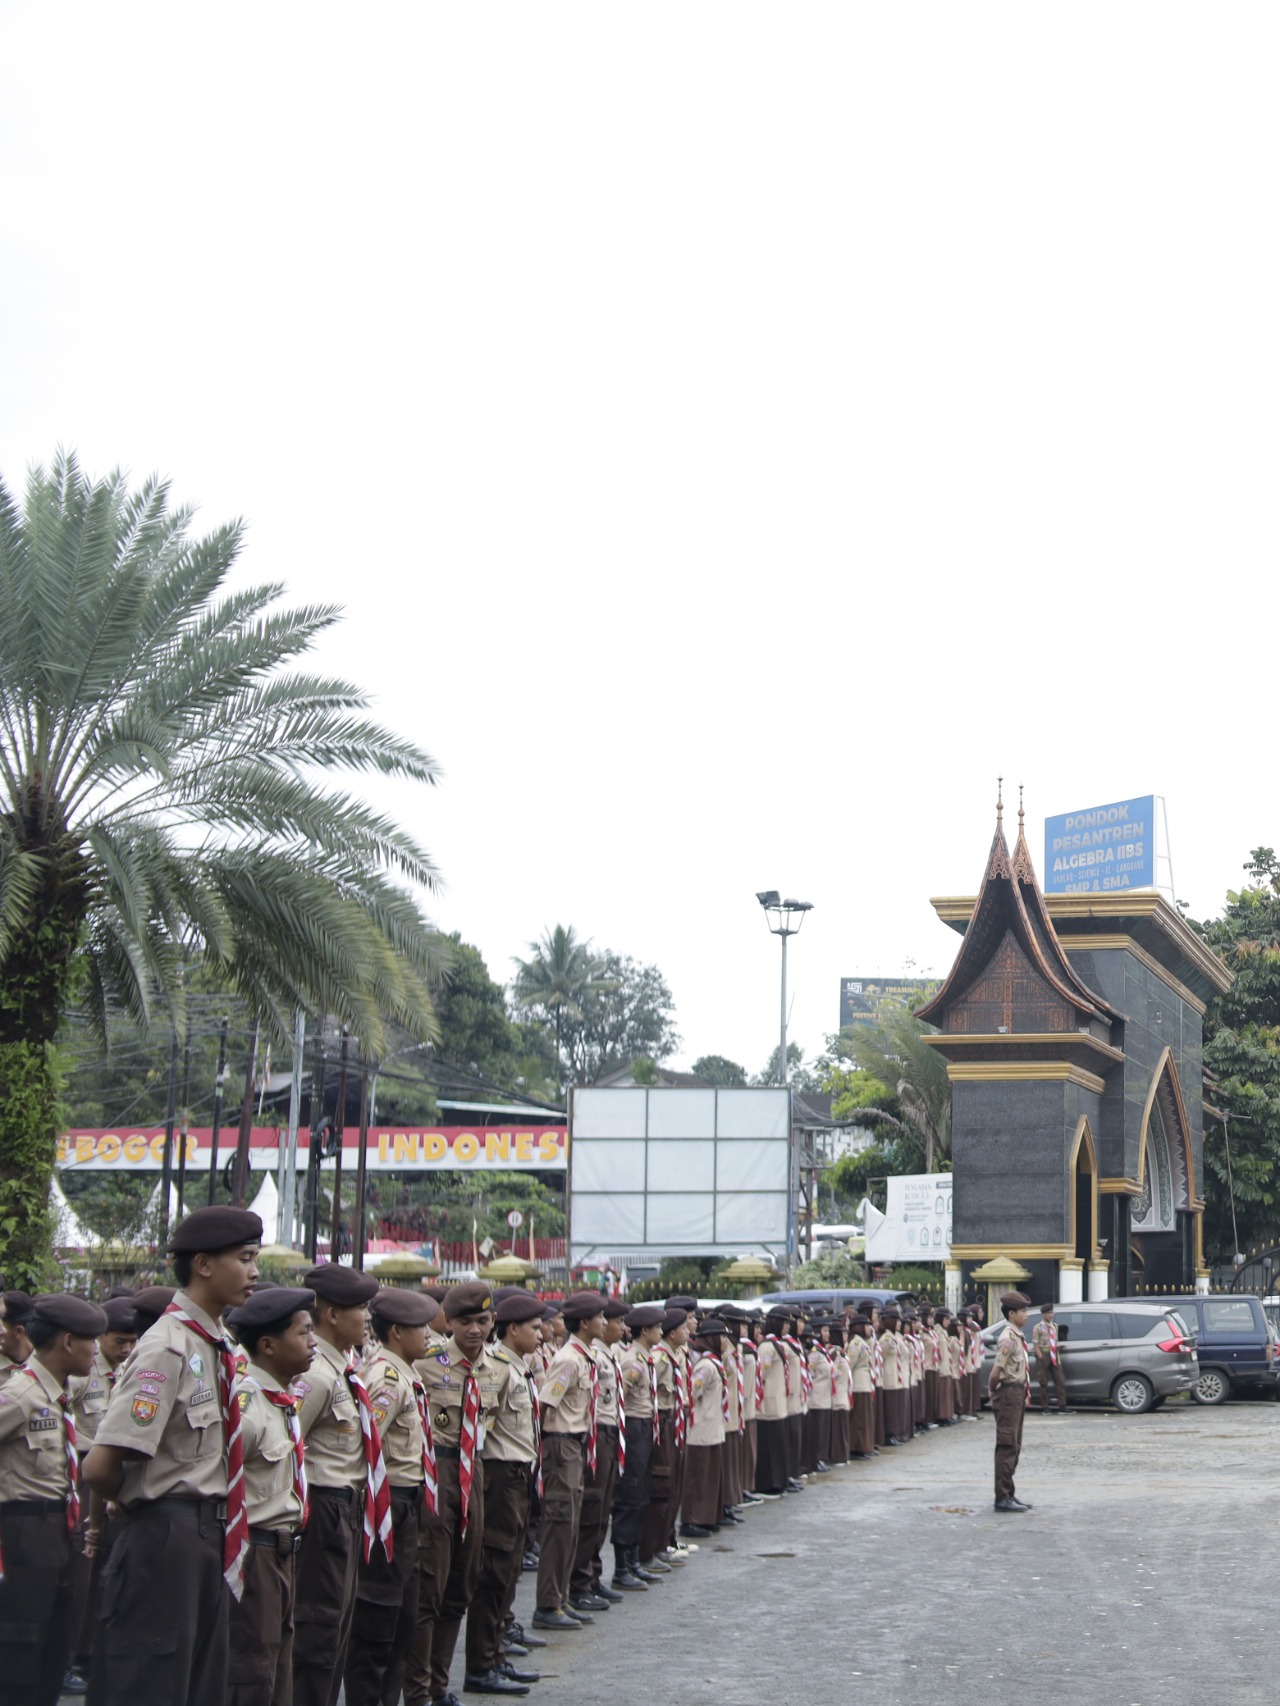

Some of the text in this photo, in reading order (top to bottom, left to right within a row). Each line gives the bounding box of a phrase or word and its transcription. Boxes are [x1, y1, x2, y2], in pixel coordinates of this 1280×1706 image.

[1065, 805, 1130, 832] PONDOK
[1053, 822, 1144, 853] PESANTREN
[1053, 842, 1144, 872] ALGEBRA IIBS
[1102, 873, 1130, 889] SMA
[75, 1133, 199, 1163] BOGOR
